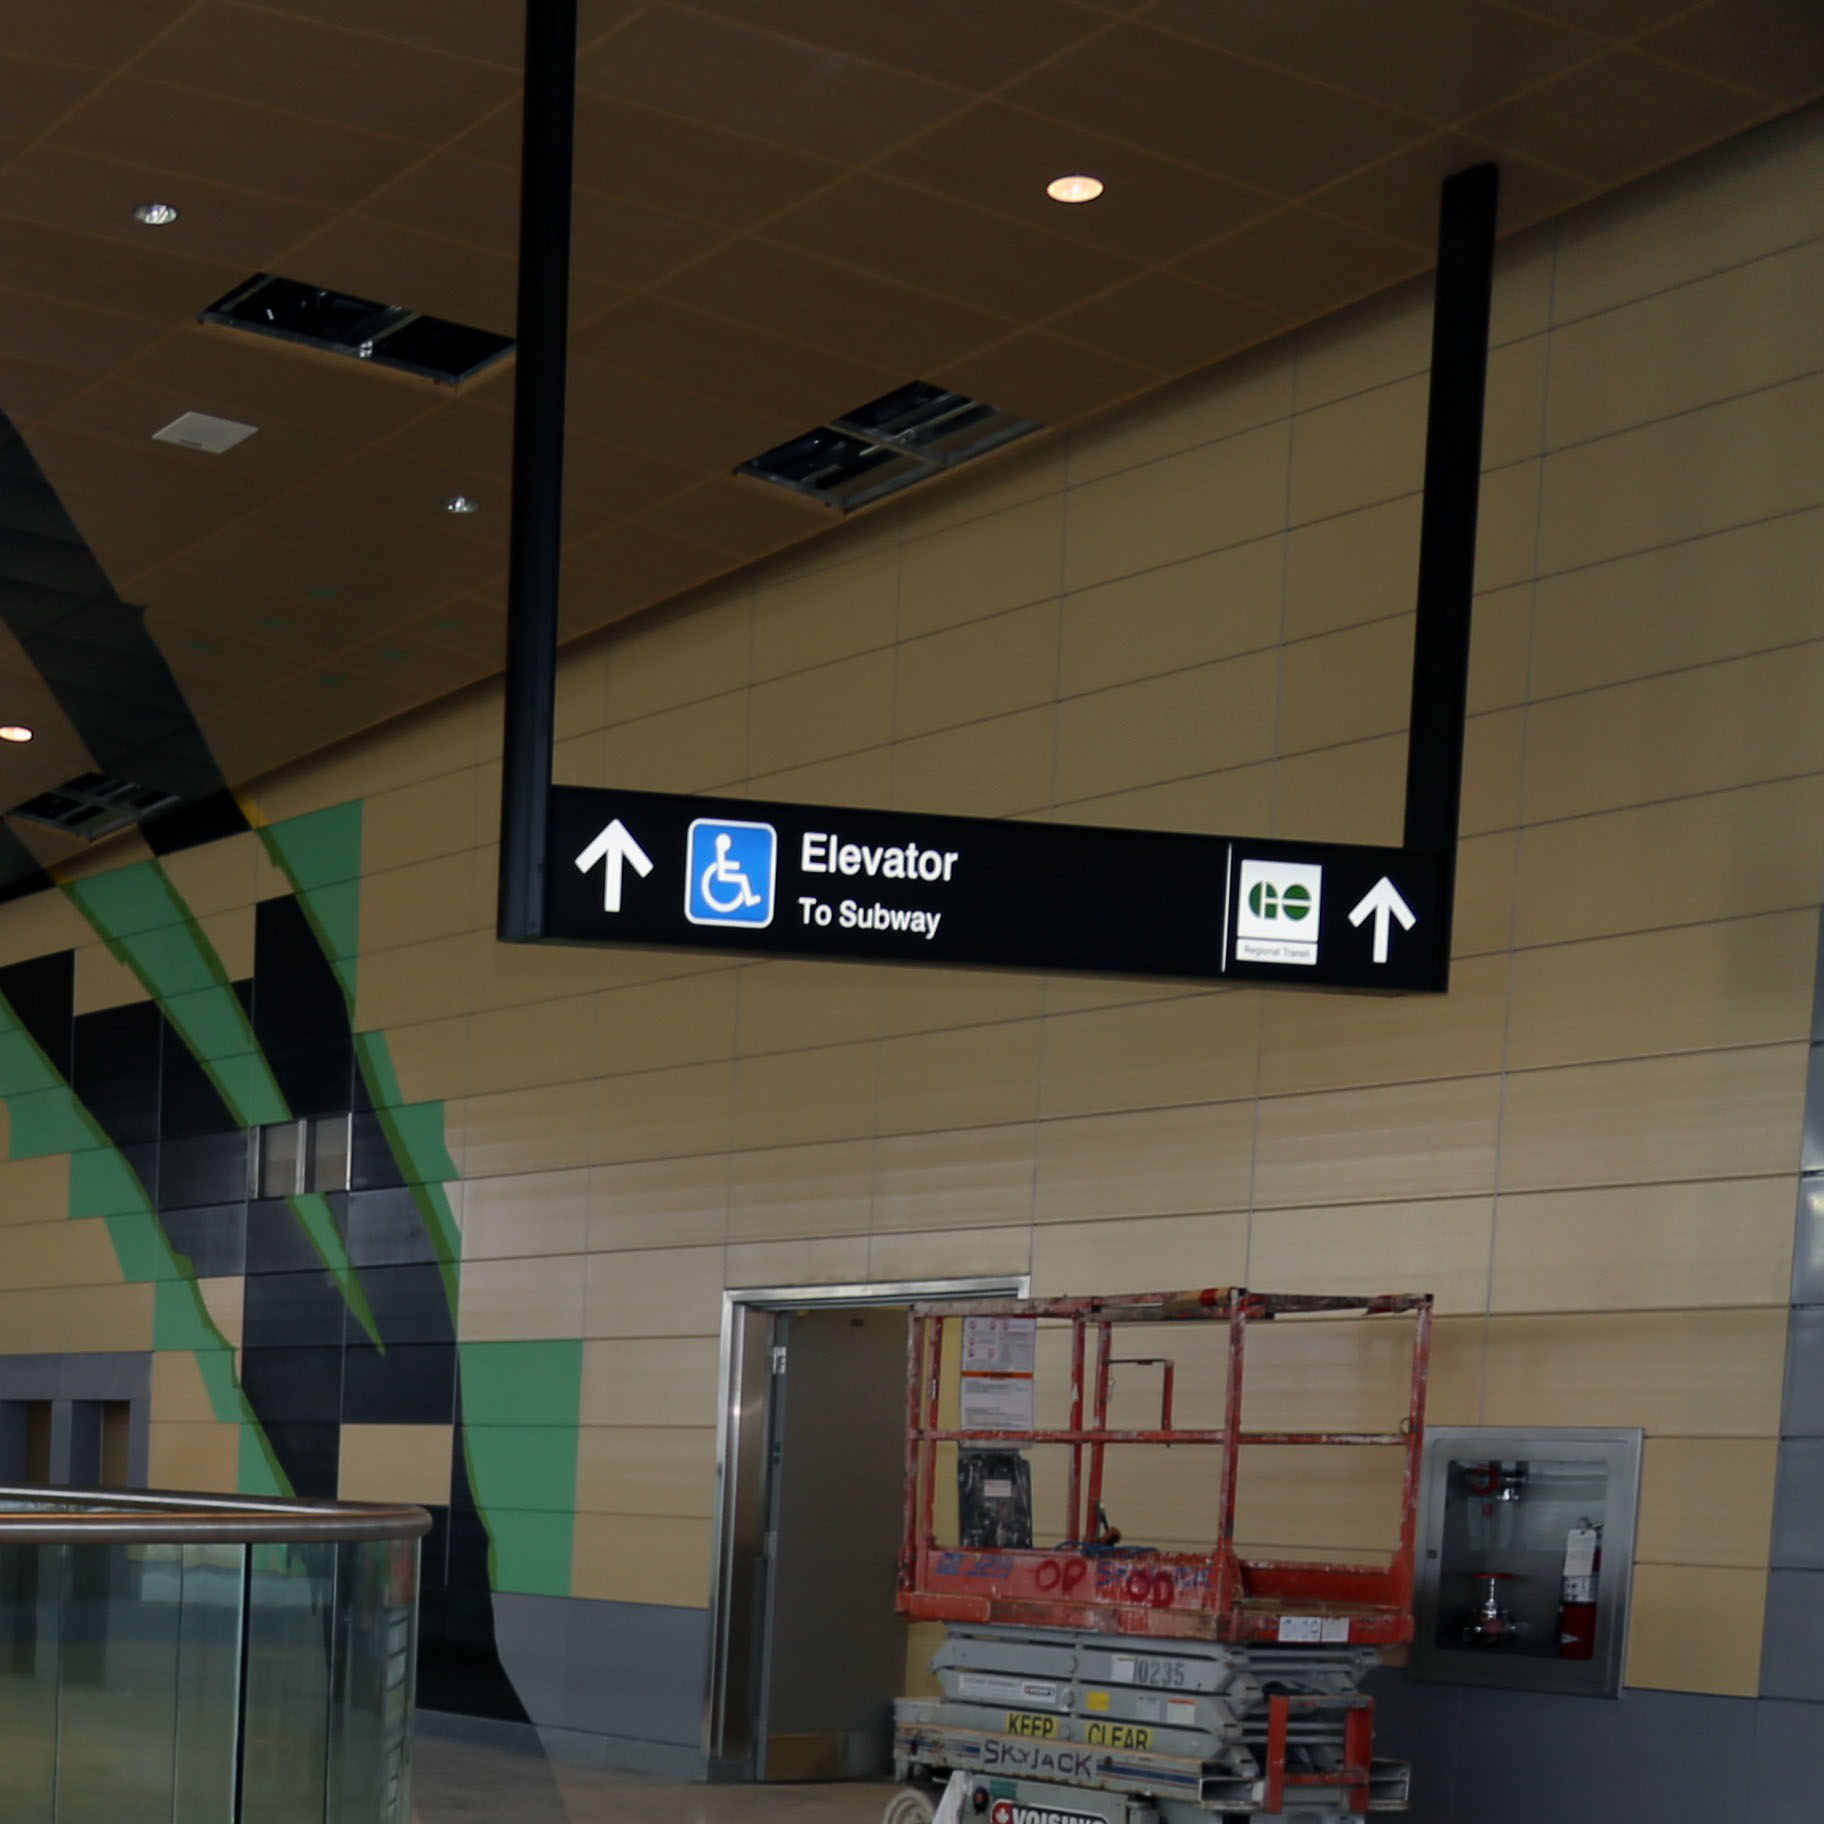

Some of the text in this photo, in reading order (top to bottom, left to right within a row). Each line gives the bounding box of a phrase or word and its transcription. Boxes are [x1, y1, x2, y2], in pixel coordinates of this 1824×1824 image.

[802, 832, 958, 881] Elevator
[798, 897, 942, 940] To Subway
